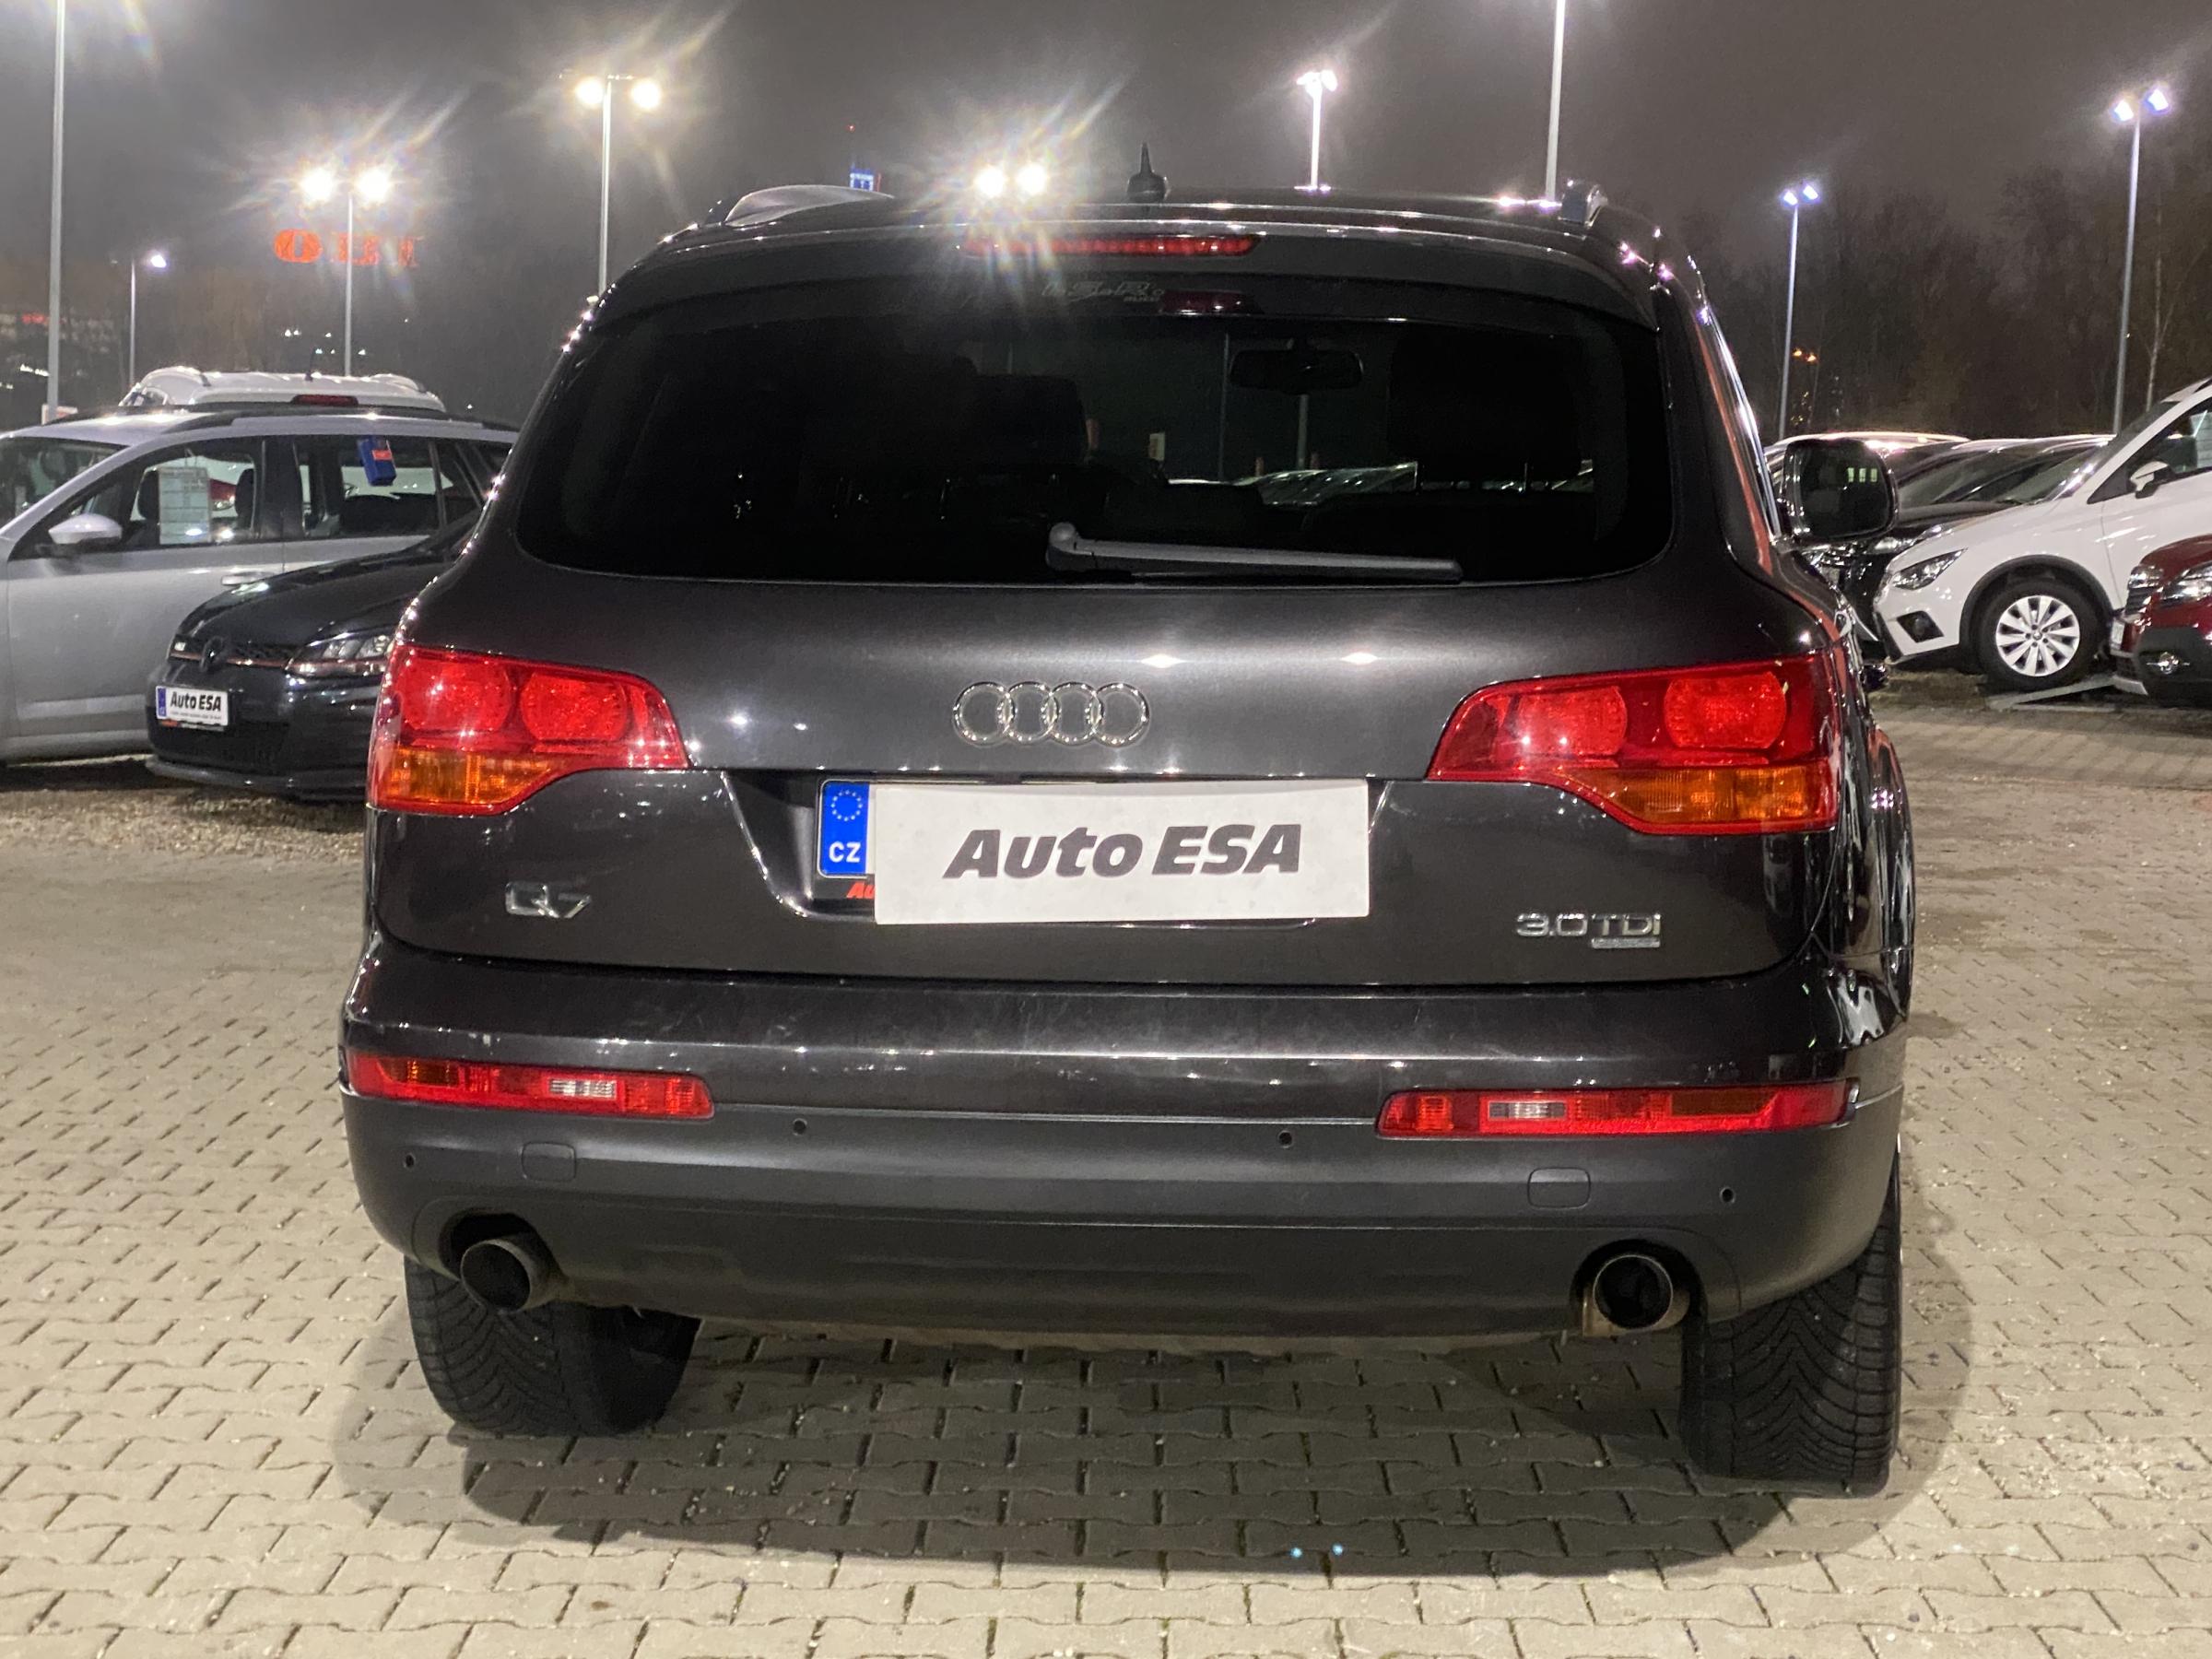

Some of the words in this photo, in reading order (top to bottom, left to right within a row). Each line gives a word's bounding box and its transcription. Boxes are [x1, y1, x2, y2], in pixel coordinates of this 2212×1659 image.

[171, 691, 197, 709] Auto
[198, 694, 222, 712] ESA
[829, 841, 862, 863] CZ
[942, 827, 1143, 878] Auto
[1151, 824, 1301, 875] ESA
[505, 881, 591, 918] Q7
[846, 881, 875, 900] Au
